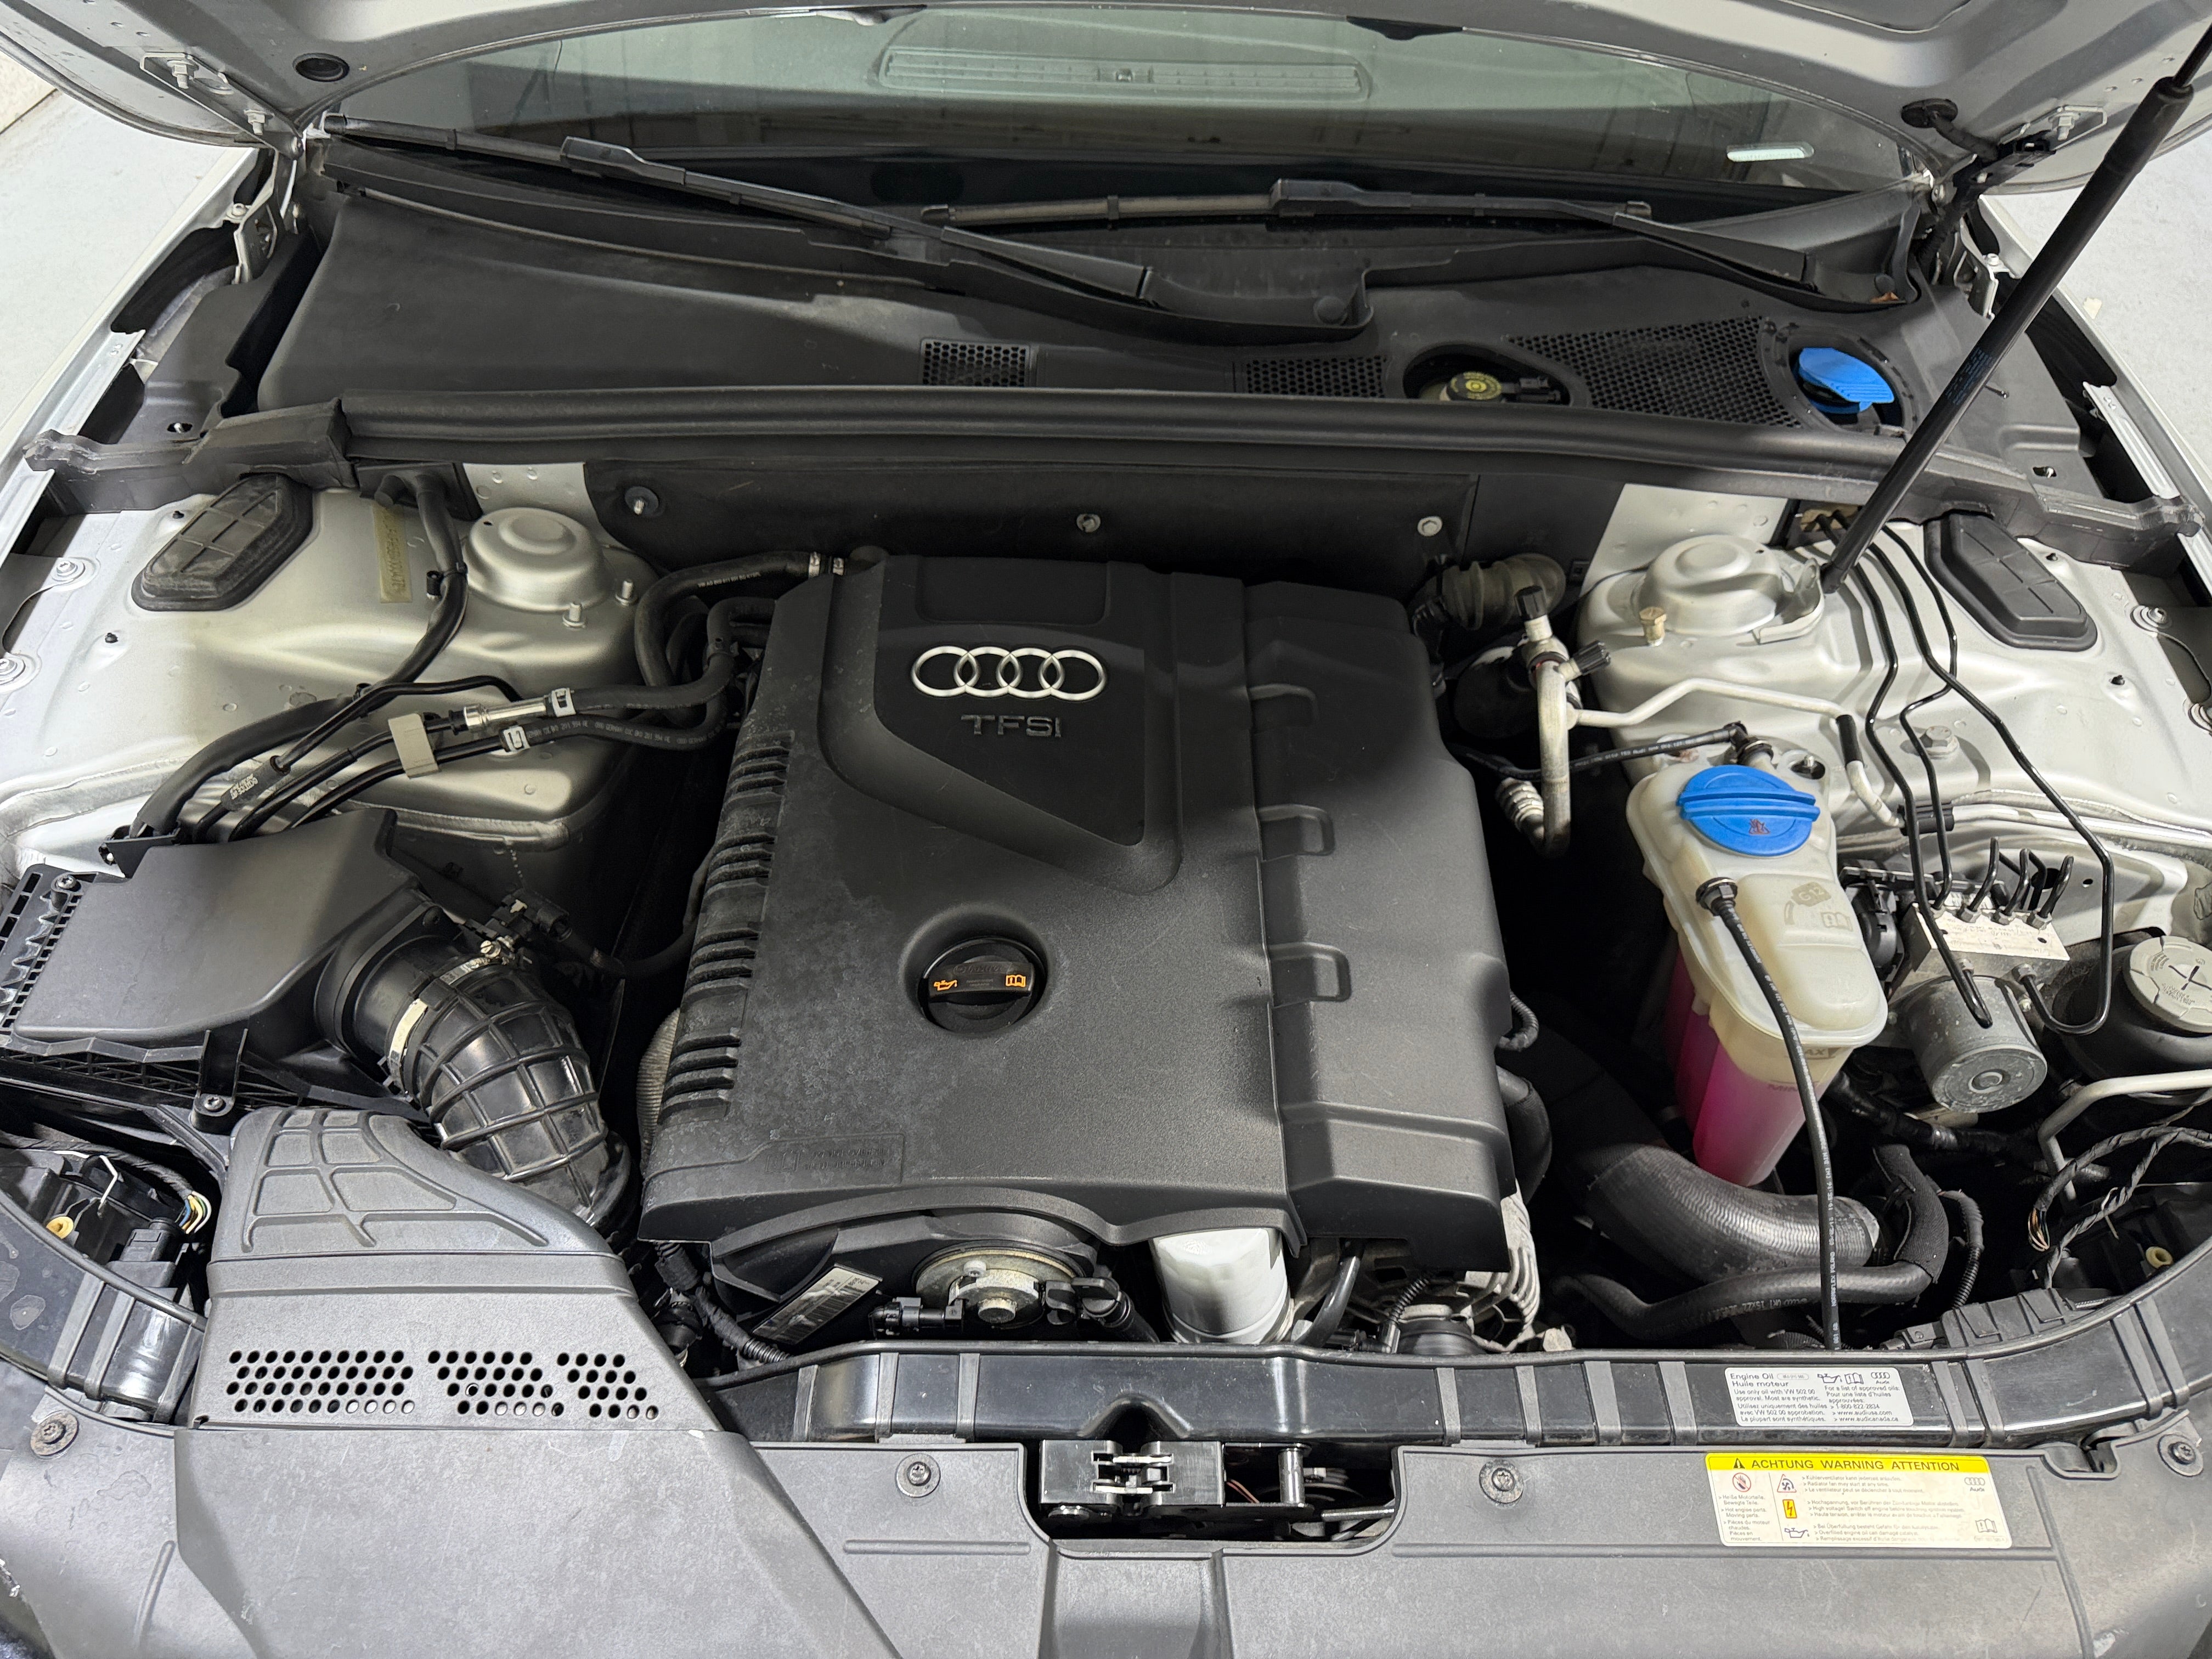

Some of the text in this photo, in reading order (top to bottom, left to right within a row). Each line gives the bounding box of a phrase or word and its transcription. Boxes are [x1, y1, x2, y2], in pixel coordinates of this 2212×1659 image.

[961, 714, 1062, 737] TFSI
[1751, 1459, 1960, 1471] ACHTUNG WARNING ATTENTION
